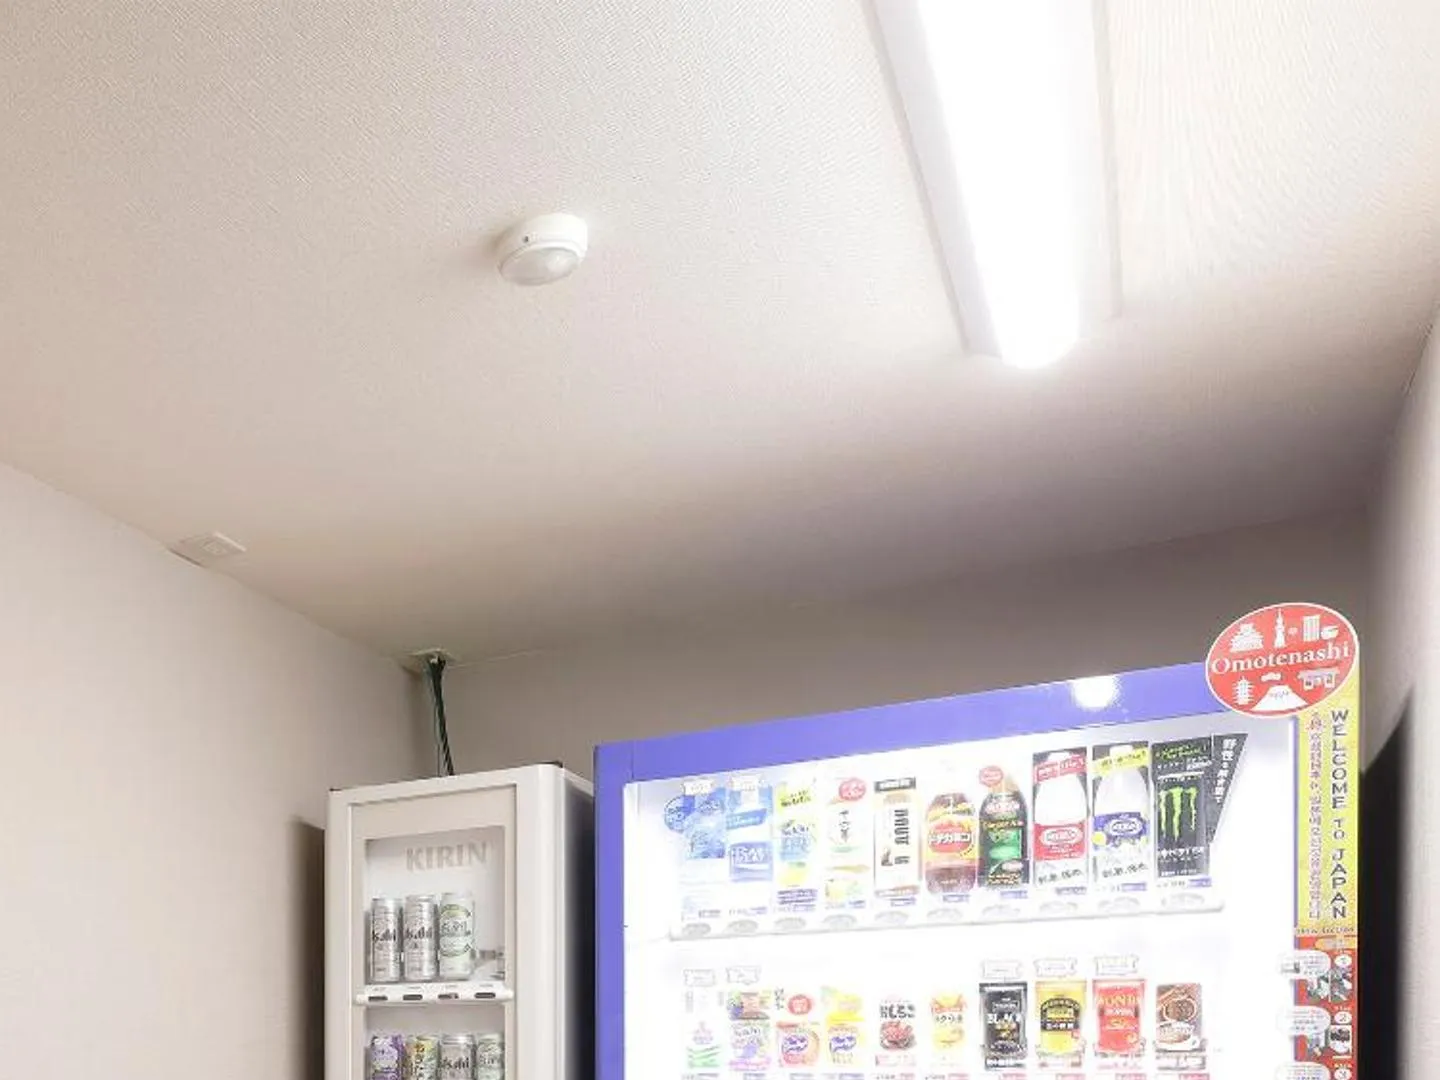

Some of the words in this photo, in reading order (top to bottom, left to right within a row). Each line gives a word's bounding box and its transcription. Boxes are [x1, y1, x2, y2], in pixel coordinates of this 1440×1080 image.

[1212, 641, 1350, 674] Omotenashi
[1332, 709, 1350, 809] WELCOME
[1333, 818, 1346, 840] TO
[405, 842, 488, 871] KIRIN
[1331, 848, 1347, 919] JAPAN
